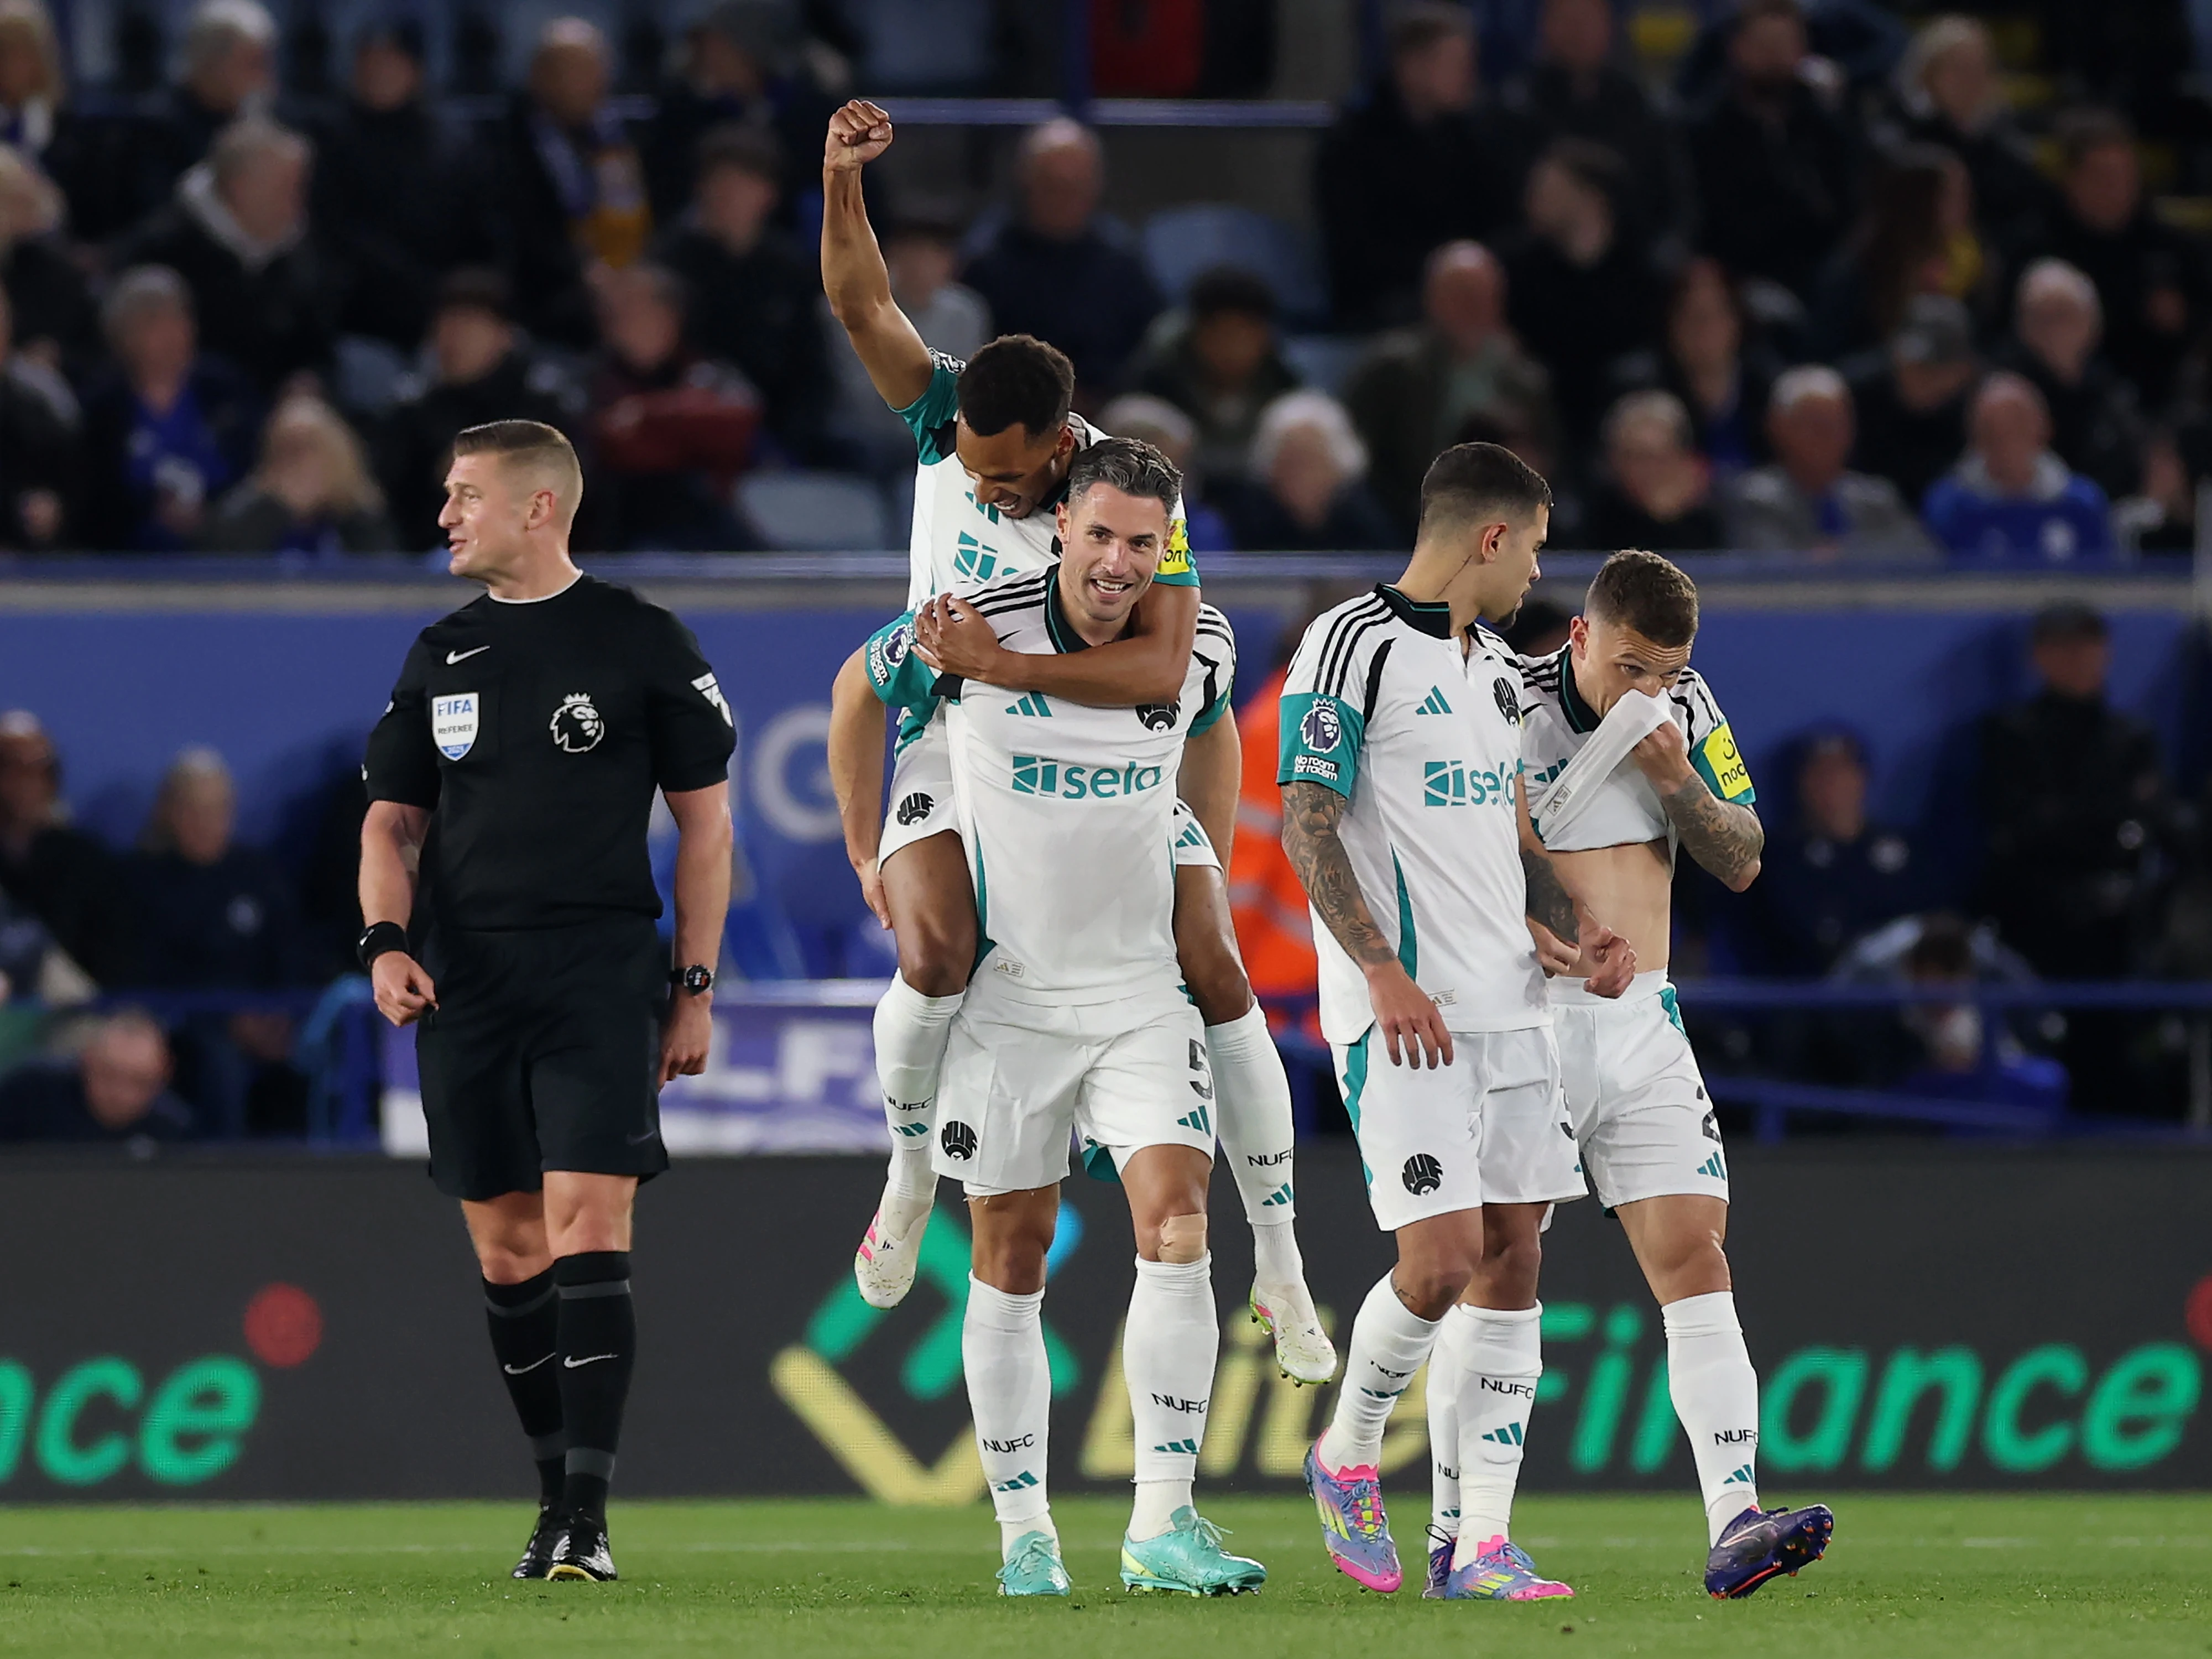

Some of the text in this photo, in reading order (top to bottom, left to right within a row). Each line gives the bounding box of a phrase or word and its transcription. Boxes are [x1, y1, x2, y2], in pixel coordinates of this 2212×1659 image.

[437, 699, 474, 717] FIFA
[438, 724, 473, 734] REFEREE
[1308, 757, 1335, 772] room
[1062, 761, 1161, 799] sela
[1188, 1037, 1213, 1100] 5
[1481, 1376, 1534, 1400] NUFC
[1150, 1392, 1207, 1413] NUFC
[982, 1433, 1034, 1453] NUFC
